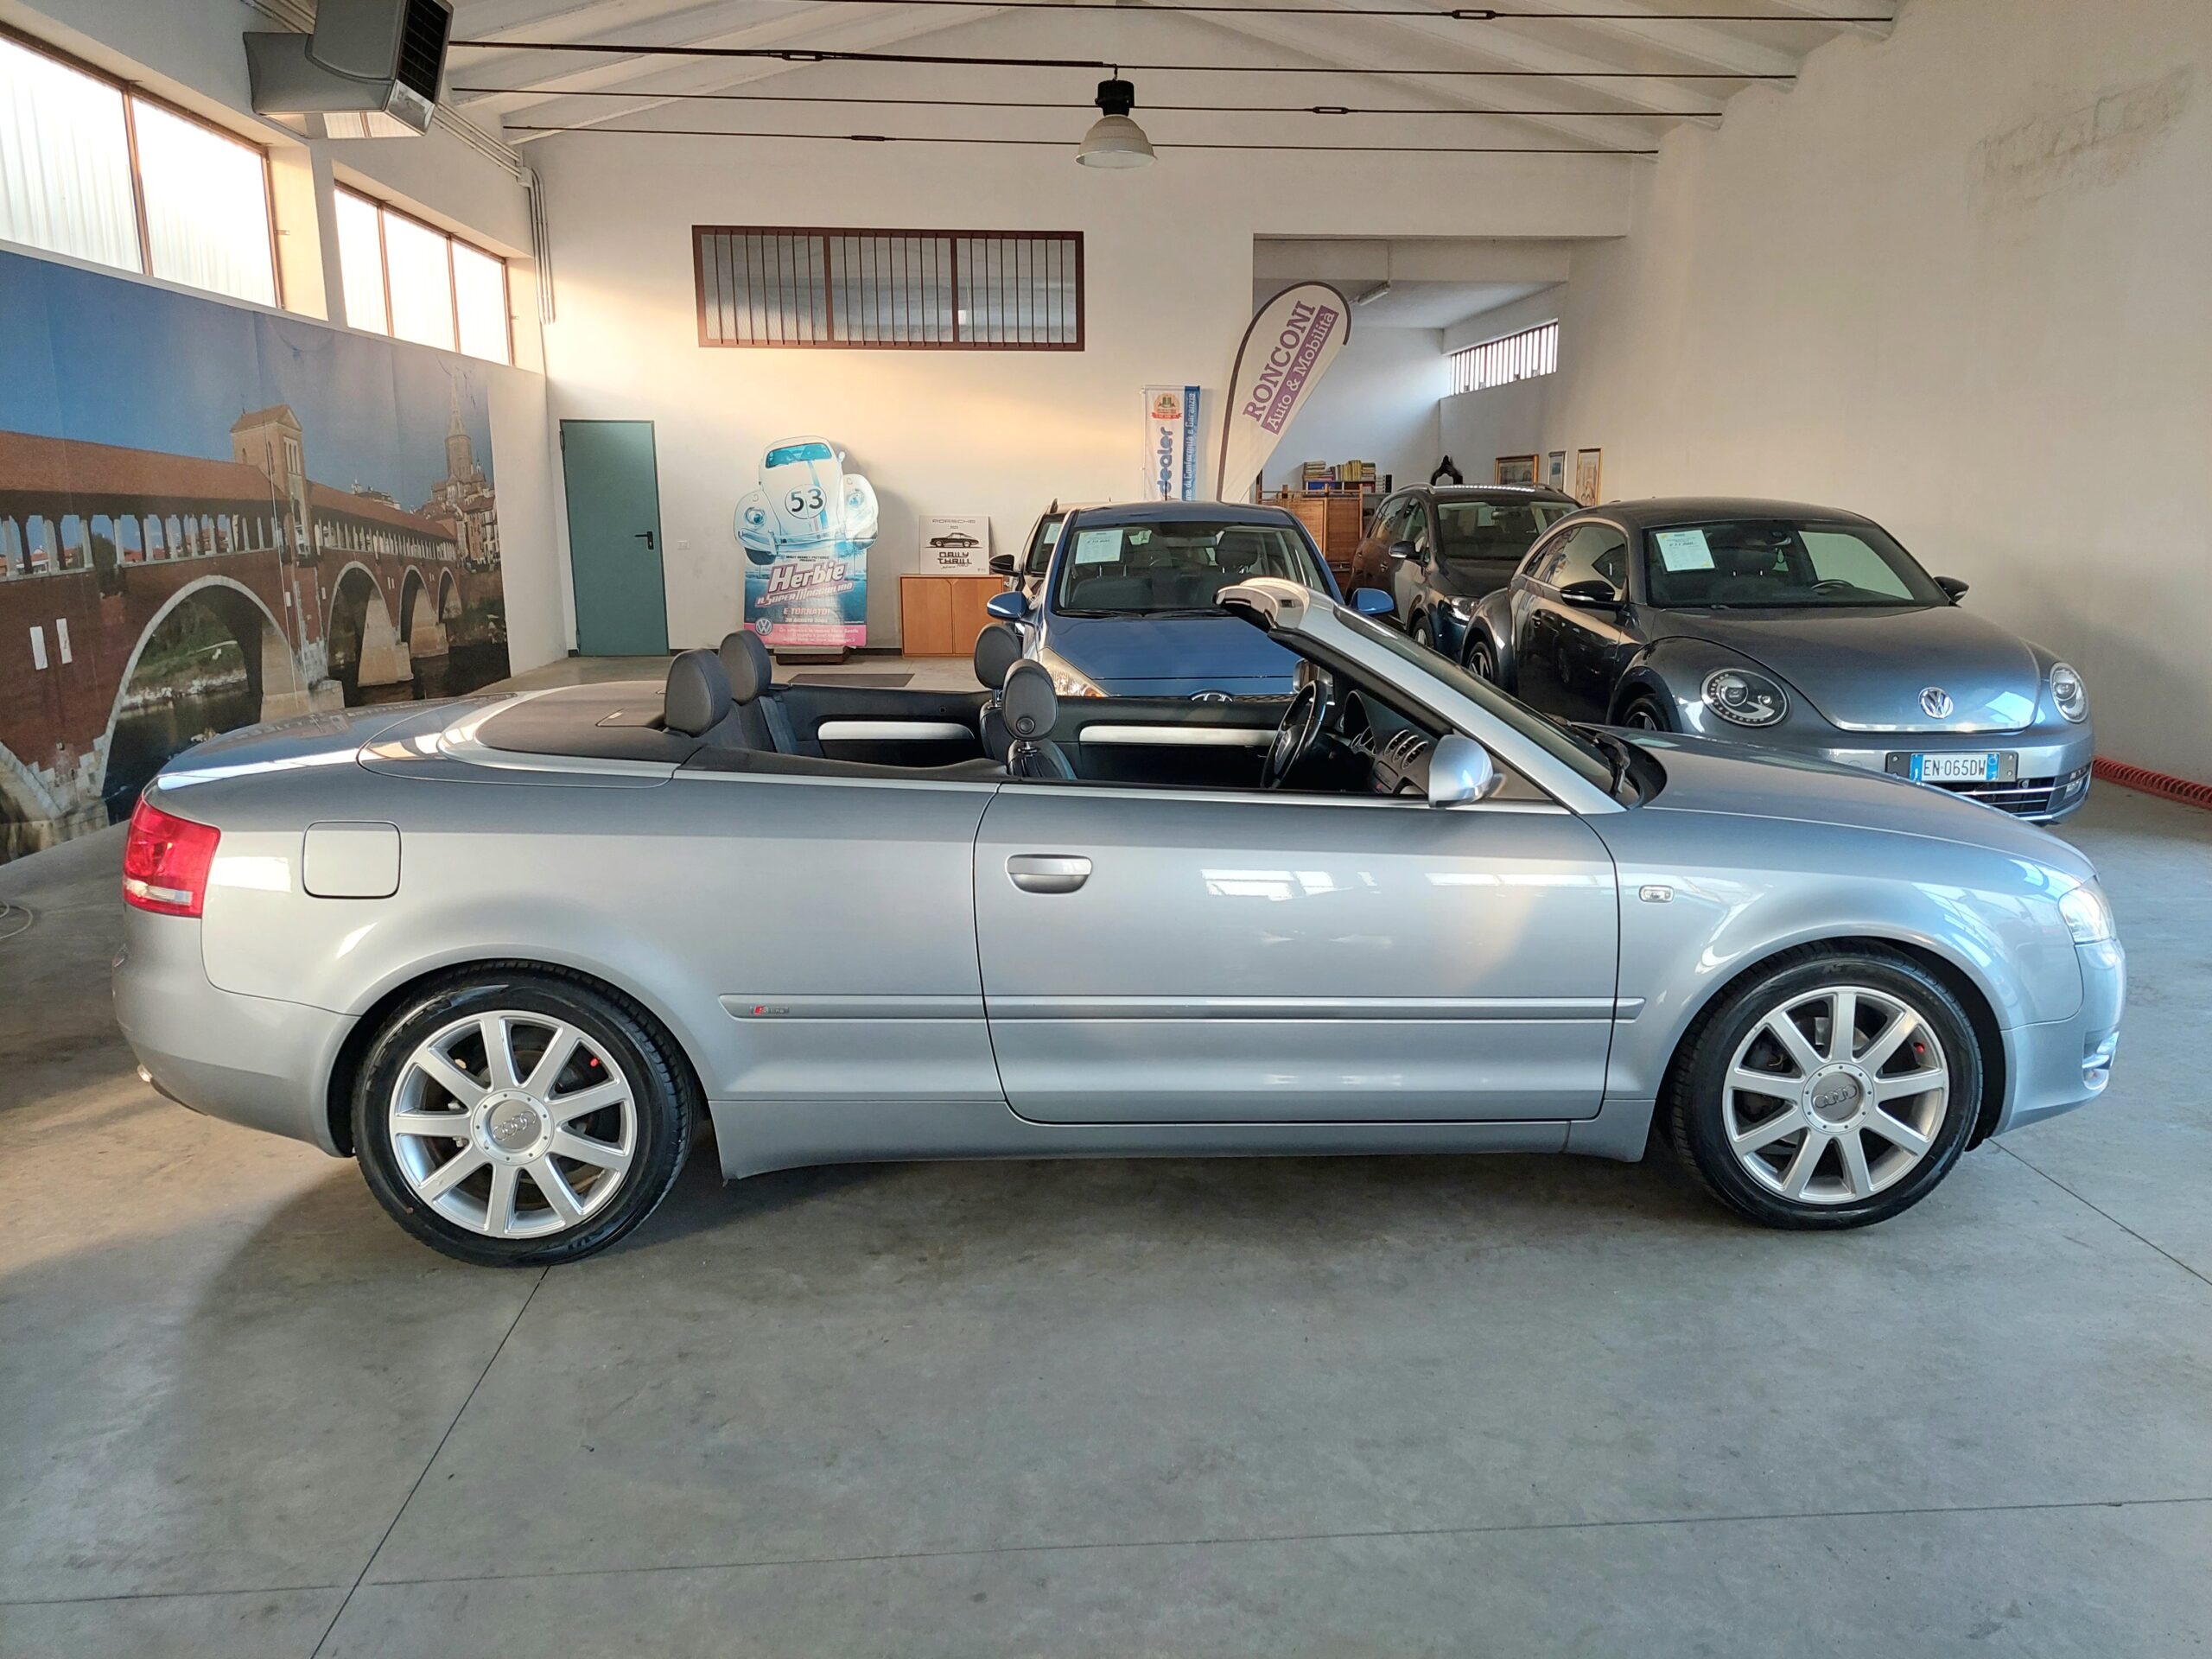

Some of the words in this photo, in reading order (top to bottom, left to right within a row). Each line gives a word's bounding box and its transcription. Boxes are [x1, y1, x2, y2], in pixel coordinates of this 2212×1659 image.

[1243, 301, 1315, 422] RONCONI
[1292, 312, 1335, 378] Mobilità
[1286, 378, 1301, 392] &
[1185, 392, 1197, 427] Garanzia
[1267, 394, 1293, 431] Auto
[791, 488, 823, 512] 53
[768, 562, 845, 593] Herbie
[1923, 760, 1941, 776] EN
[1944, 760, 1986, 776] 065DW
